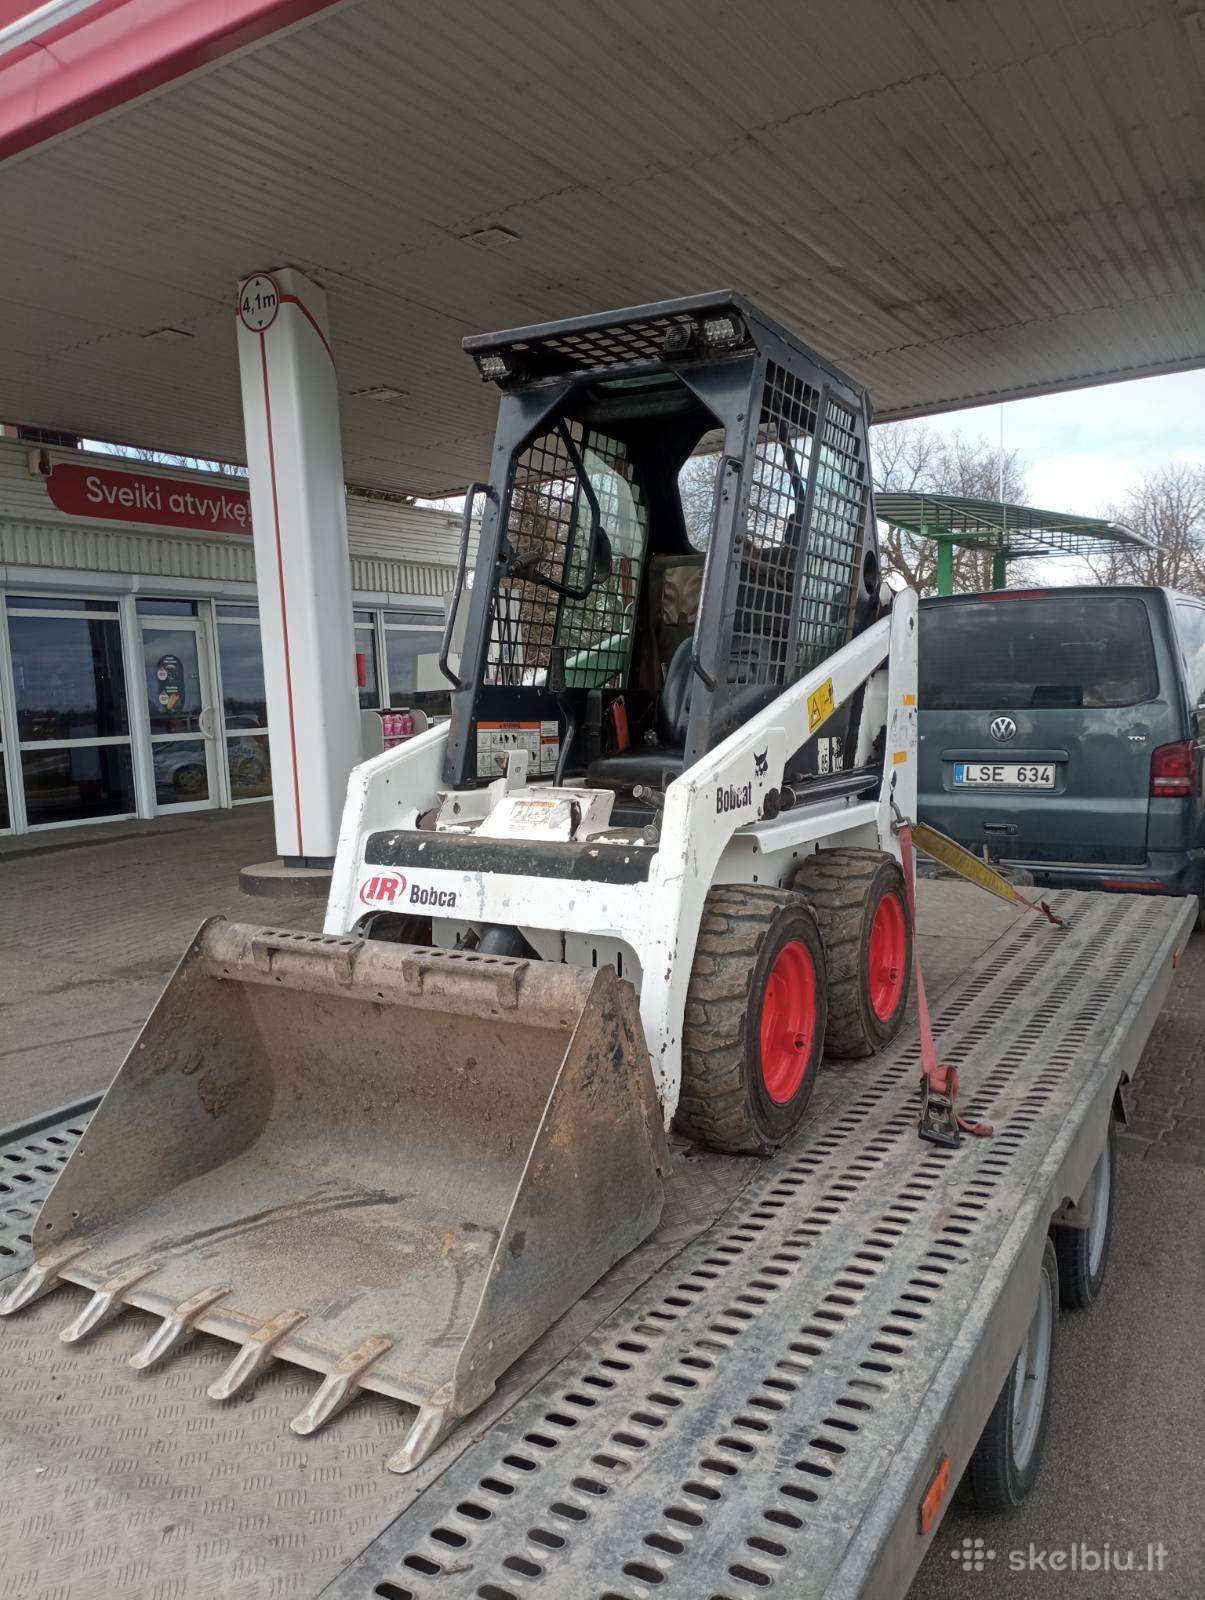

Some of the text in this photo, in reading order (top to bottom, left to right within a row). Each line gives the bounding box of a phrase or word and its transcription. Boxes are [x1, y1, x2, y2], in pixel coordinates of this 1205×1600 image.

[86, 476, 162, 511] Sveiki
[966, 766, 1050, 783] LSE 634
[716, 781, 752, 814] Bobcat
